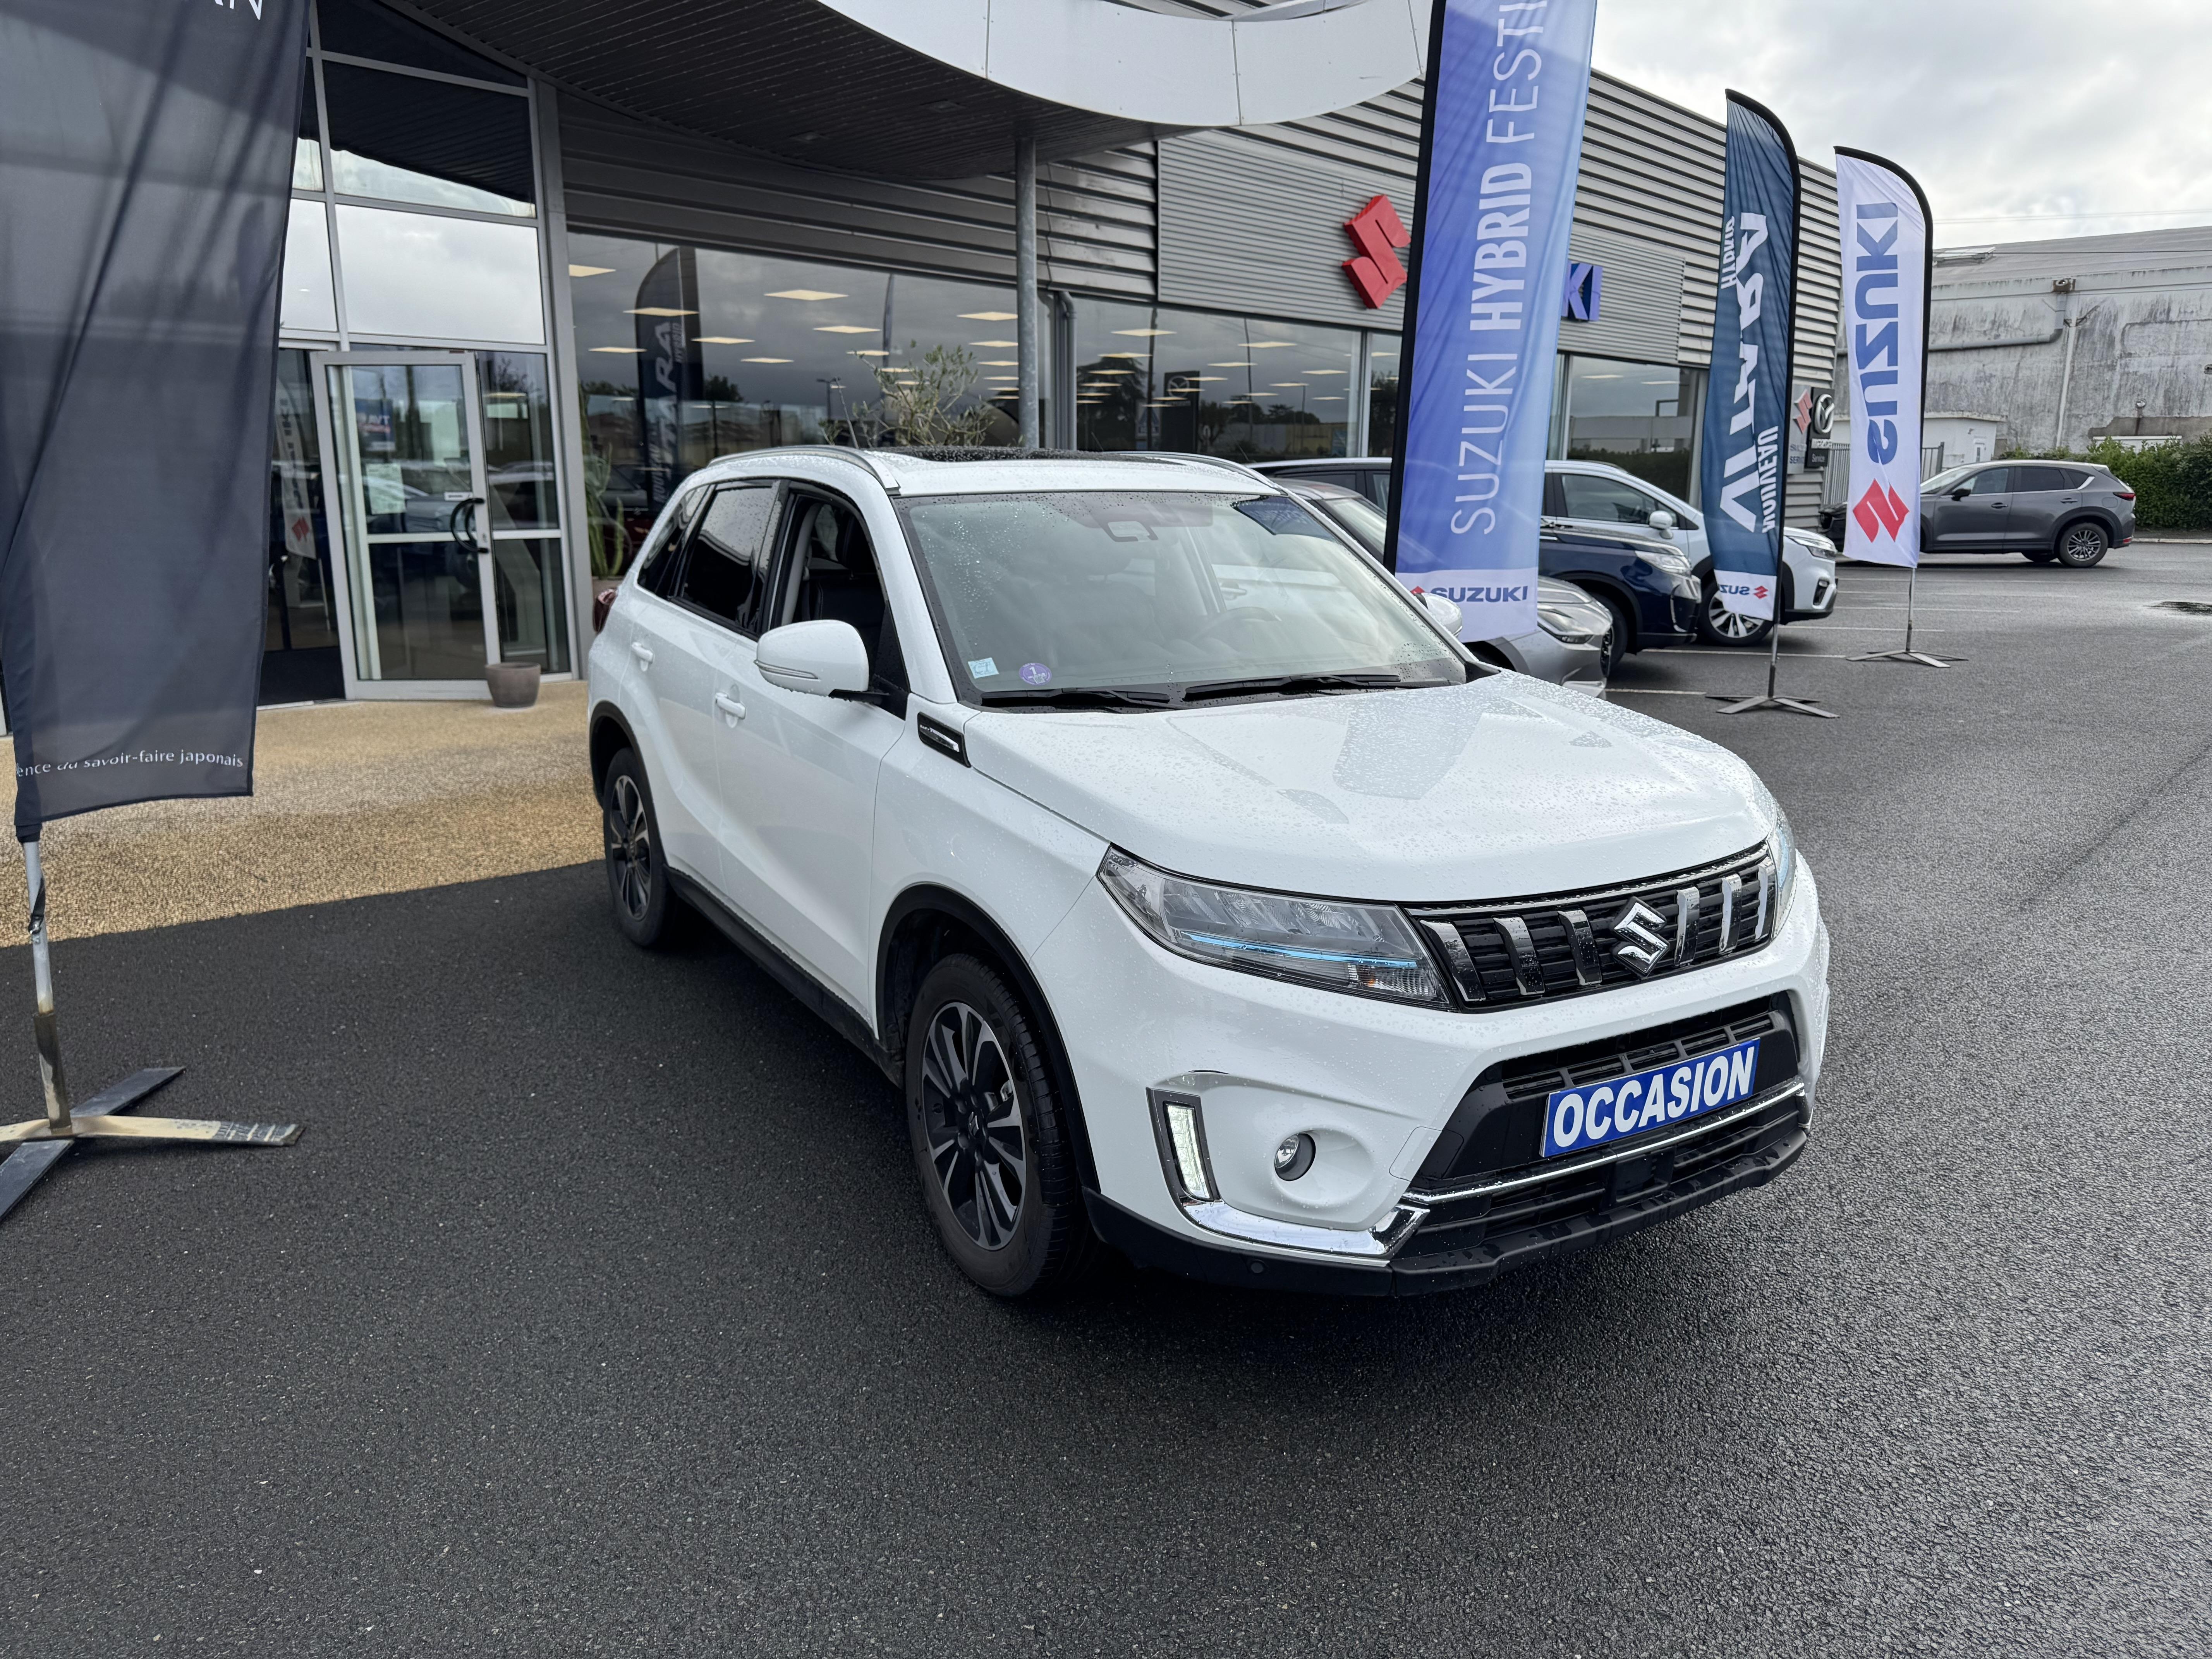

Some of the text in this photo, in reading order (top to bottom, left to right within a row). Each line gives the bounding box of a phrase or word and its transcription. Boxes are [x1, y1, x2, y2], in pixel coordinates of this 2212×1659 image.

[1451, 0, 1547, 535] SUZUKI HYBRID FESTI
[1561, 260, 1603, 321] KI
[1430, 585, 1528, 603] SUZUKI
[1029, 666, 1037, 675] 1
[17, 763, 51, 777] ence
[83, 749, 175, 768] savoir-faire
[180, 749, 244, 768] japonais
[1553, 1046, 1755, 1147] OCCASION
